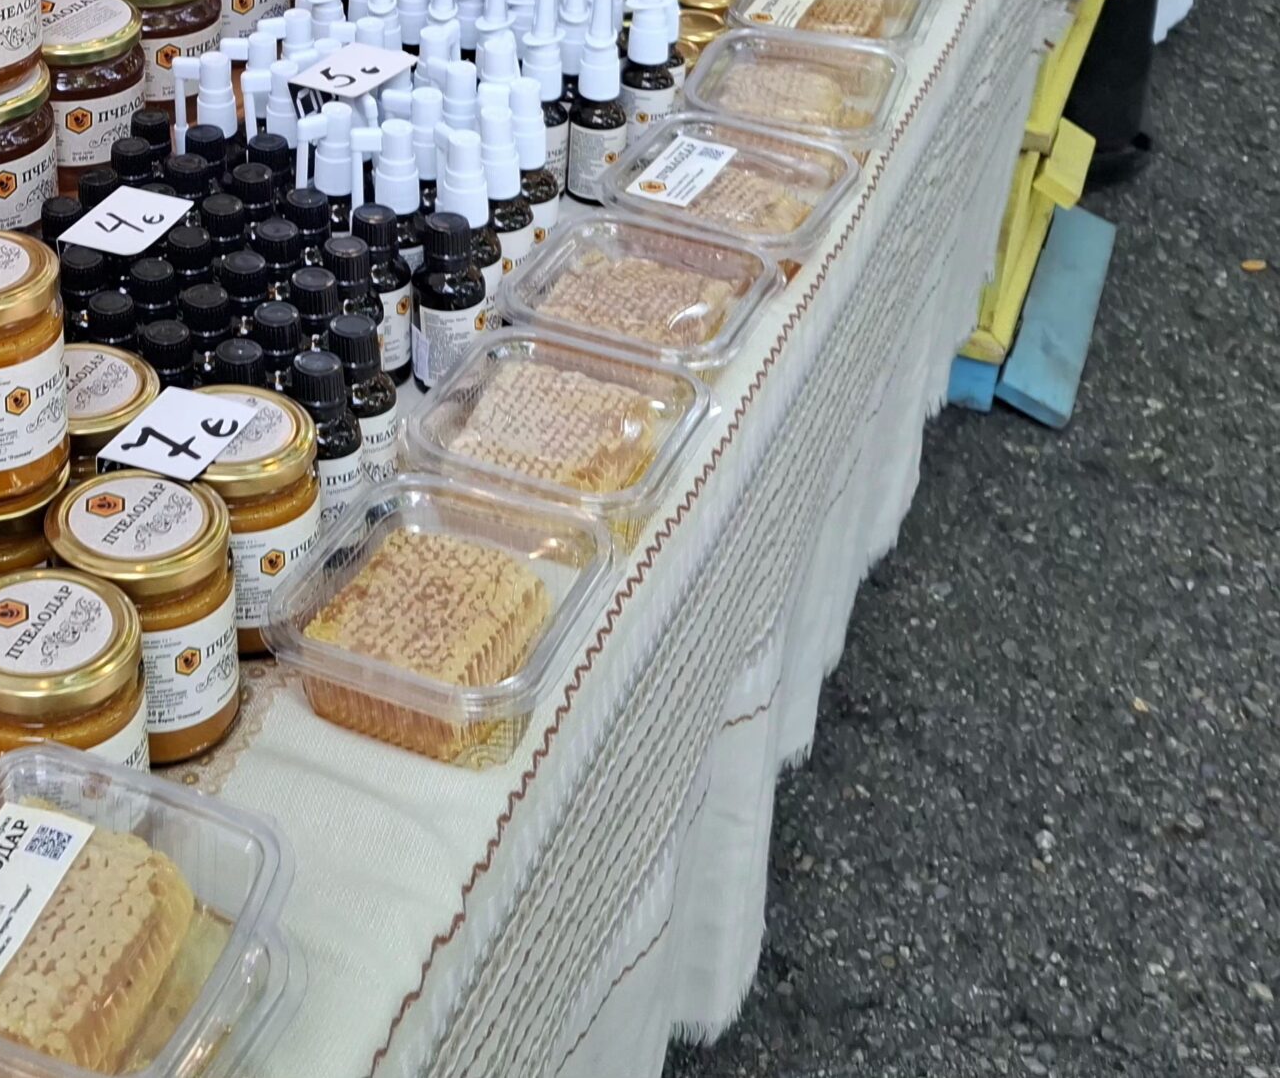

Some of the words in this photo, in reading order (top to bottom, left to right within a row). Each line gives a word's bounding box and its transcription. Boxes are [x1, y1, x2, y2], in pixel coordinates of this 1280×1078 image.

[186, 31, 221, 58] ПЧЕЛО
[97, 90, 145, 123] ПЧЕЛОД
[21, 143, 56, 183] ПЧЕЛО
[121, 417, 239, 460] 7€
[325, 465, 362, 487] ПЧЕЛ
[100, 481, 168, 546] ПЧЕЛОДАР
[4, 584, 73, 661] ПЧЕЛОДАР
